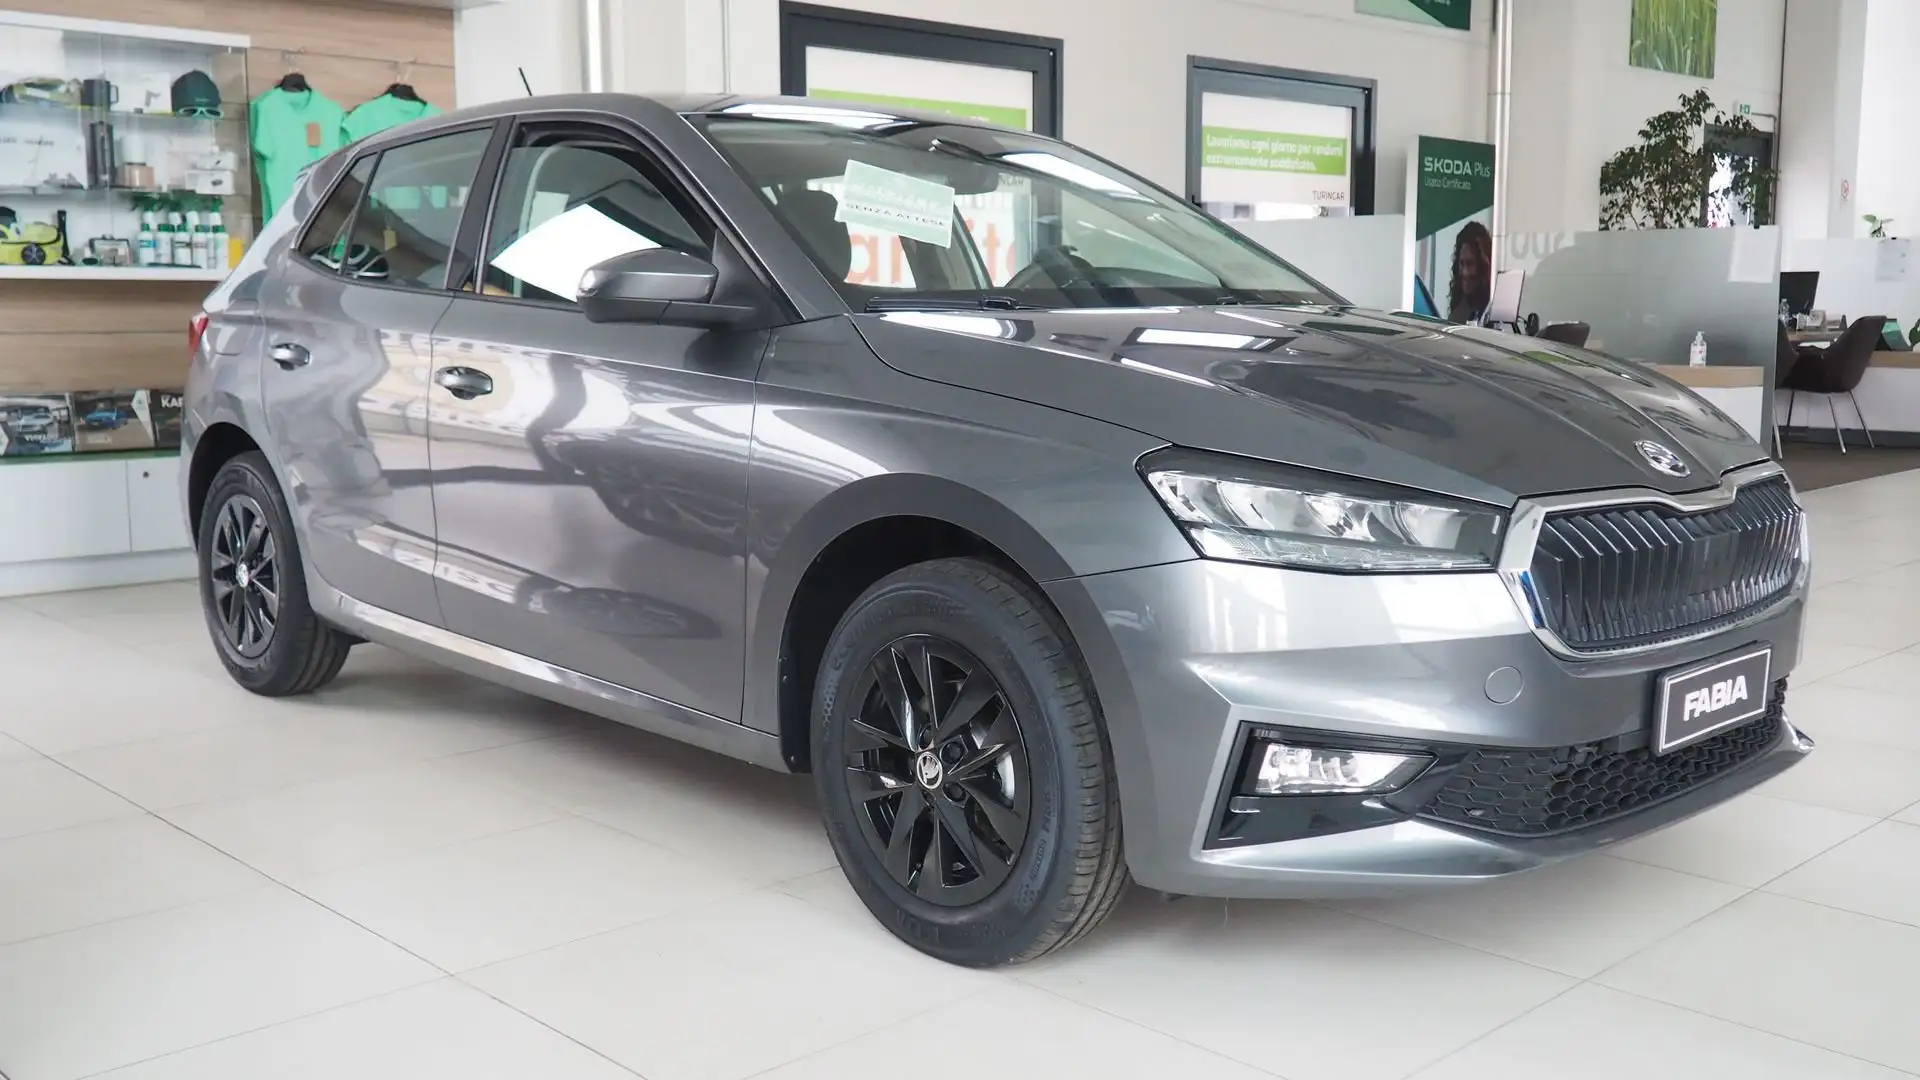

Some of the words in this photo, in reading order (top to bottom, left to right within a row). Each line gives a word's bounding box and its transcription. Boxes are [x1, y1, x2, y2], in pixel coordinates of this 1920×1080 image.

[1252, 138, 1270, 154] ogni
[1271, 140, 1297, 156] giorno
[1297, 144, 1312, 157] per
[1474, 162, 1491, 178] Plus
[1312, 190, 1345, 201] TURINCAR
[1683, 675, 1748, 722] FABIA
